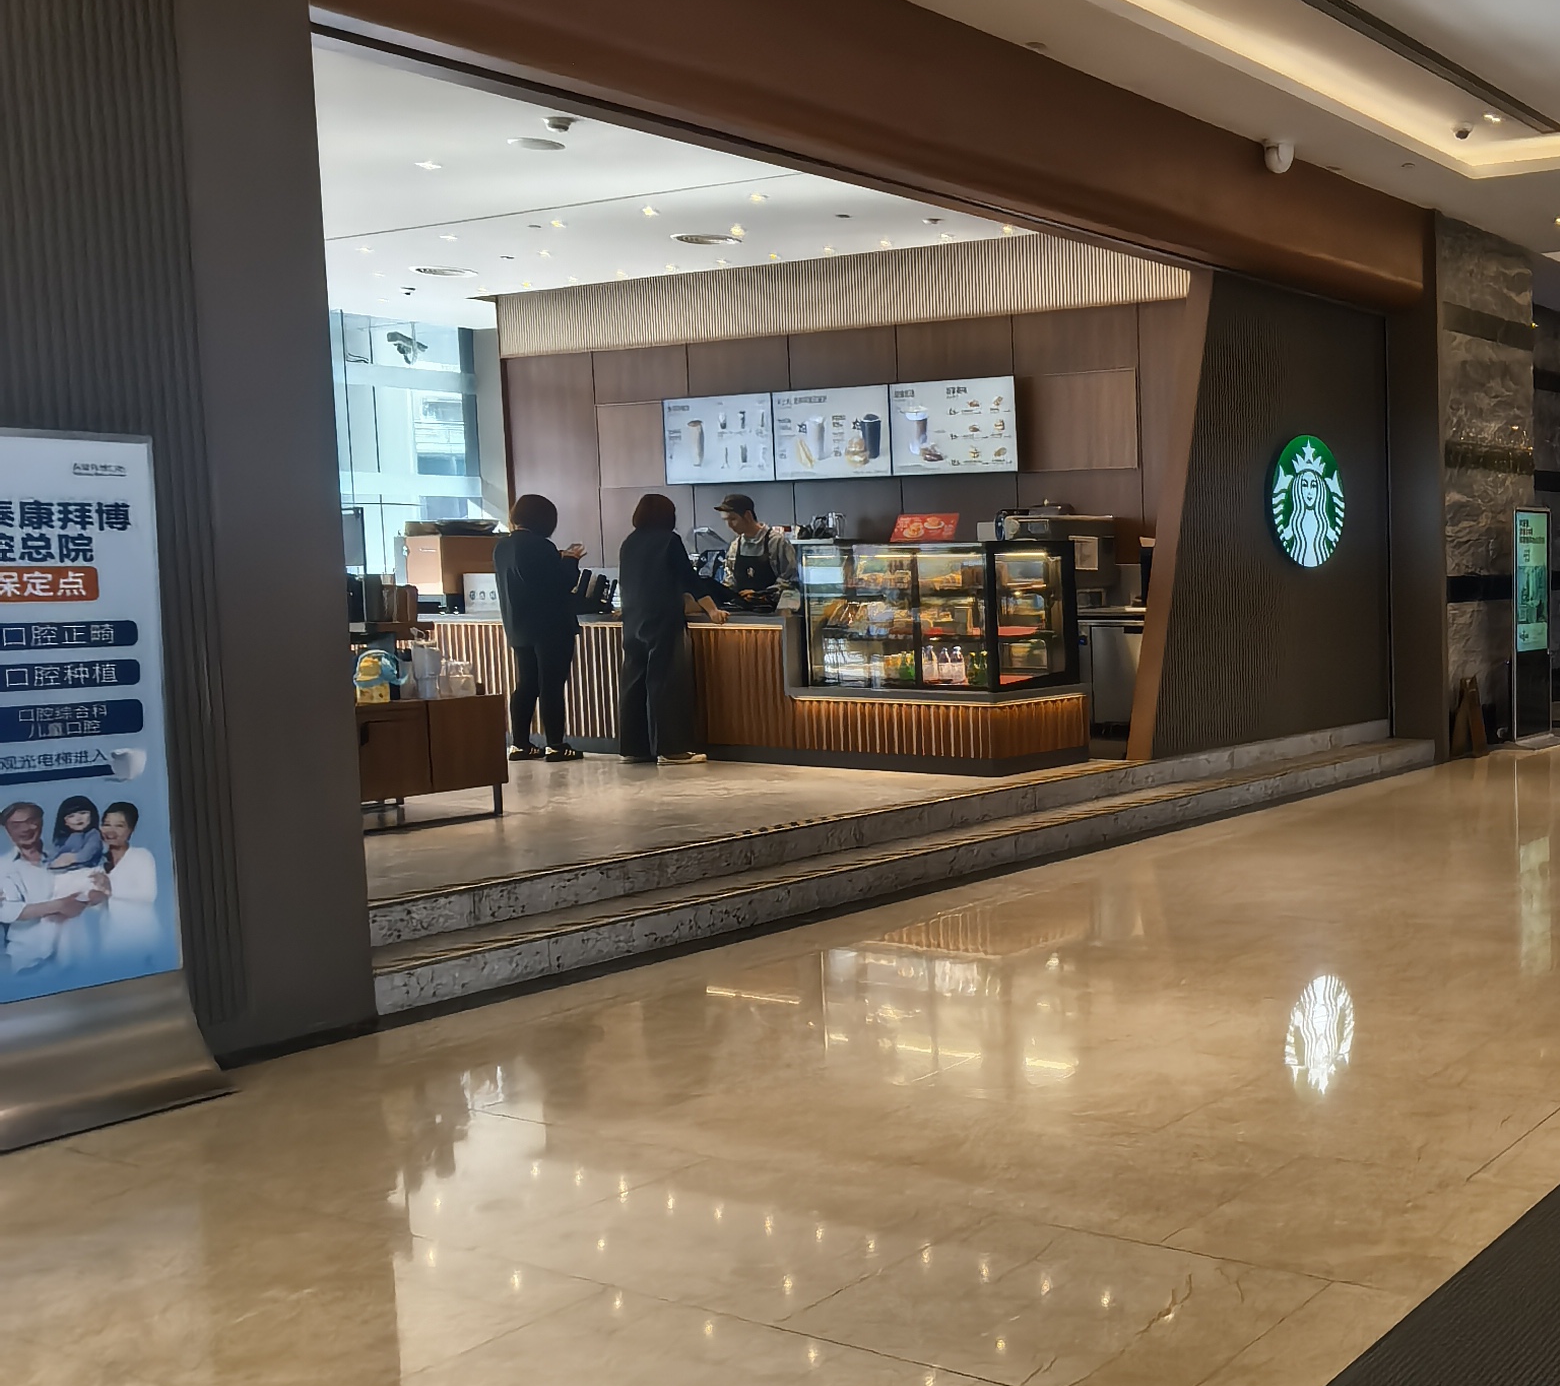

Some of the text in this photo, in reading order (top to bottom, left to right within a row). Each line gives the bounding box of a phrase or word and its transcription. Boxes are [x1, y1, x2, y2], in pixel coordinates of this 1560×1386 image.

[3, 624, 115, 646] 口腔正畸
[6, 664, 118, 687] 口腔种植
[18, 704, 107, 722] 口腔综合科
